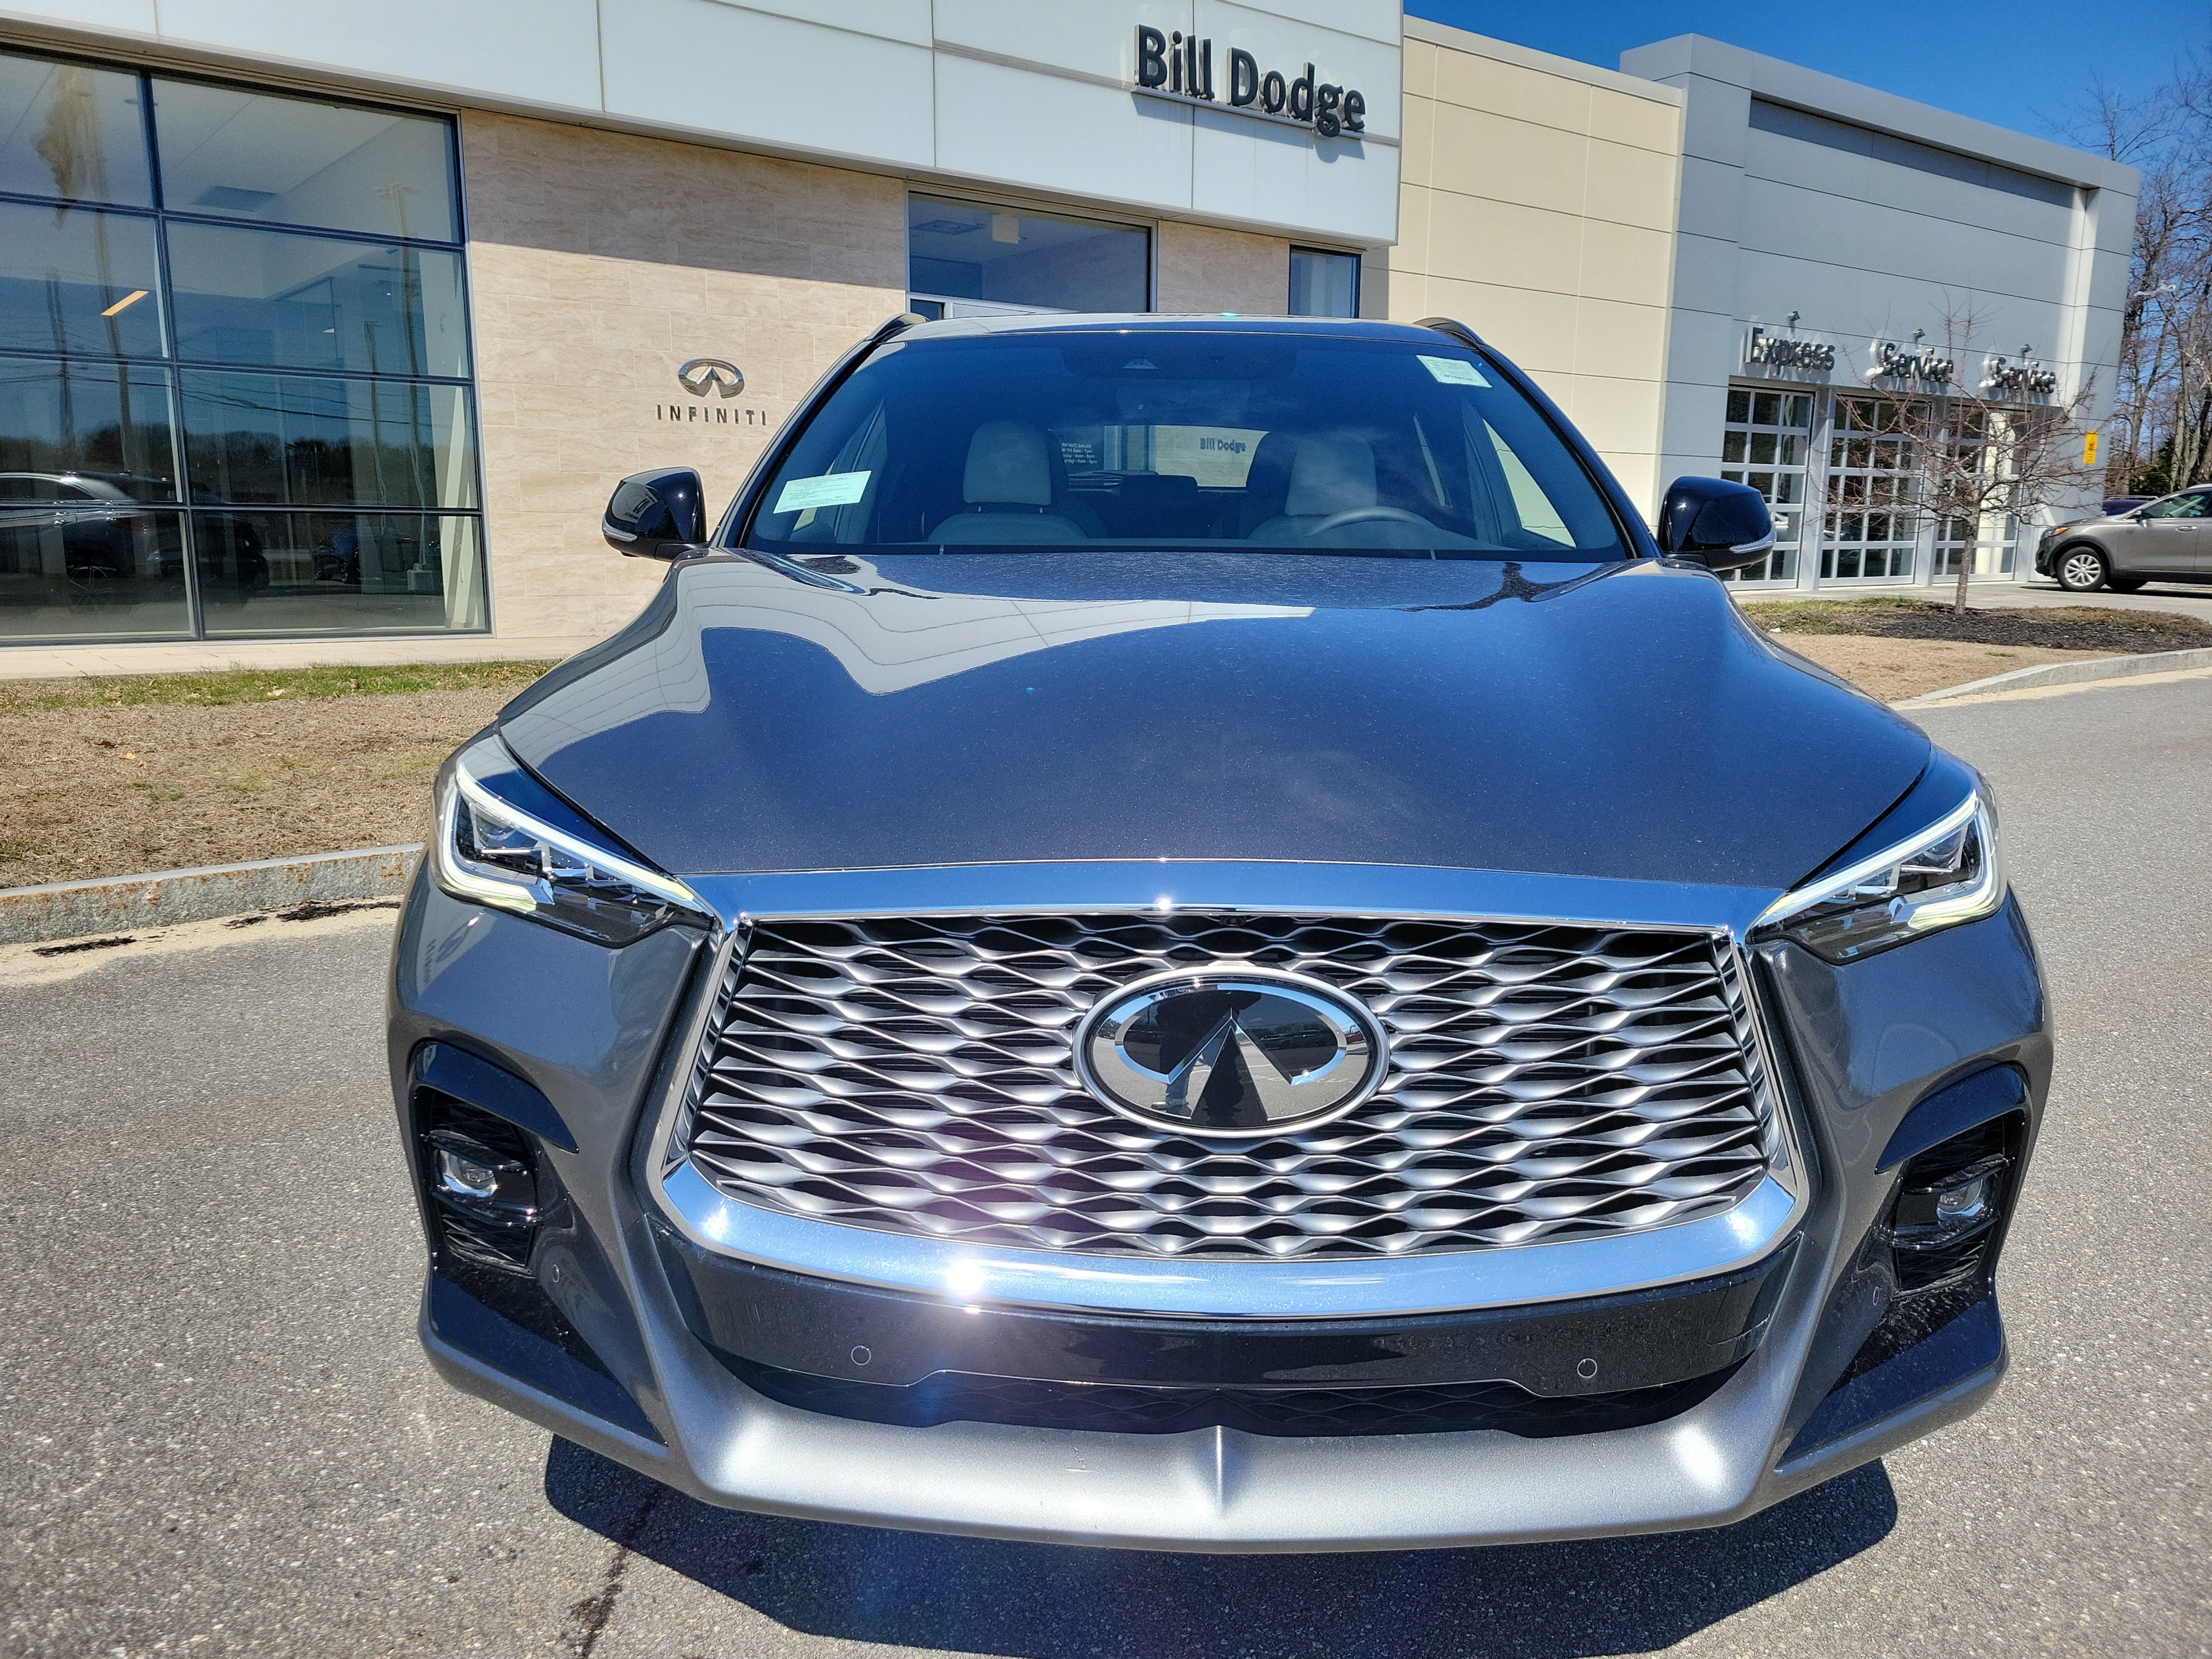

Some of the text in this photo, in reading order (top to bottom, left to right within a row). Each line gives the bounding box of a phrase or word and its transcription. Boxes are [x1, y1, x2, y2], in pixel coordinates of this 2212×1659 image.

[1134, 24, 1366, 137] Bill Dodge
[1746, 327, 1835, 375] Express
[657, 404, 766, 426] INFINITI
[1200, 438, 1245, 454] Bill Dodge
